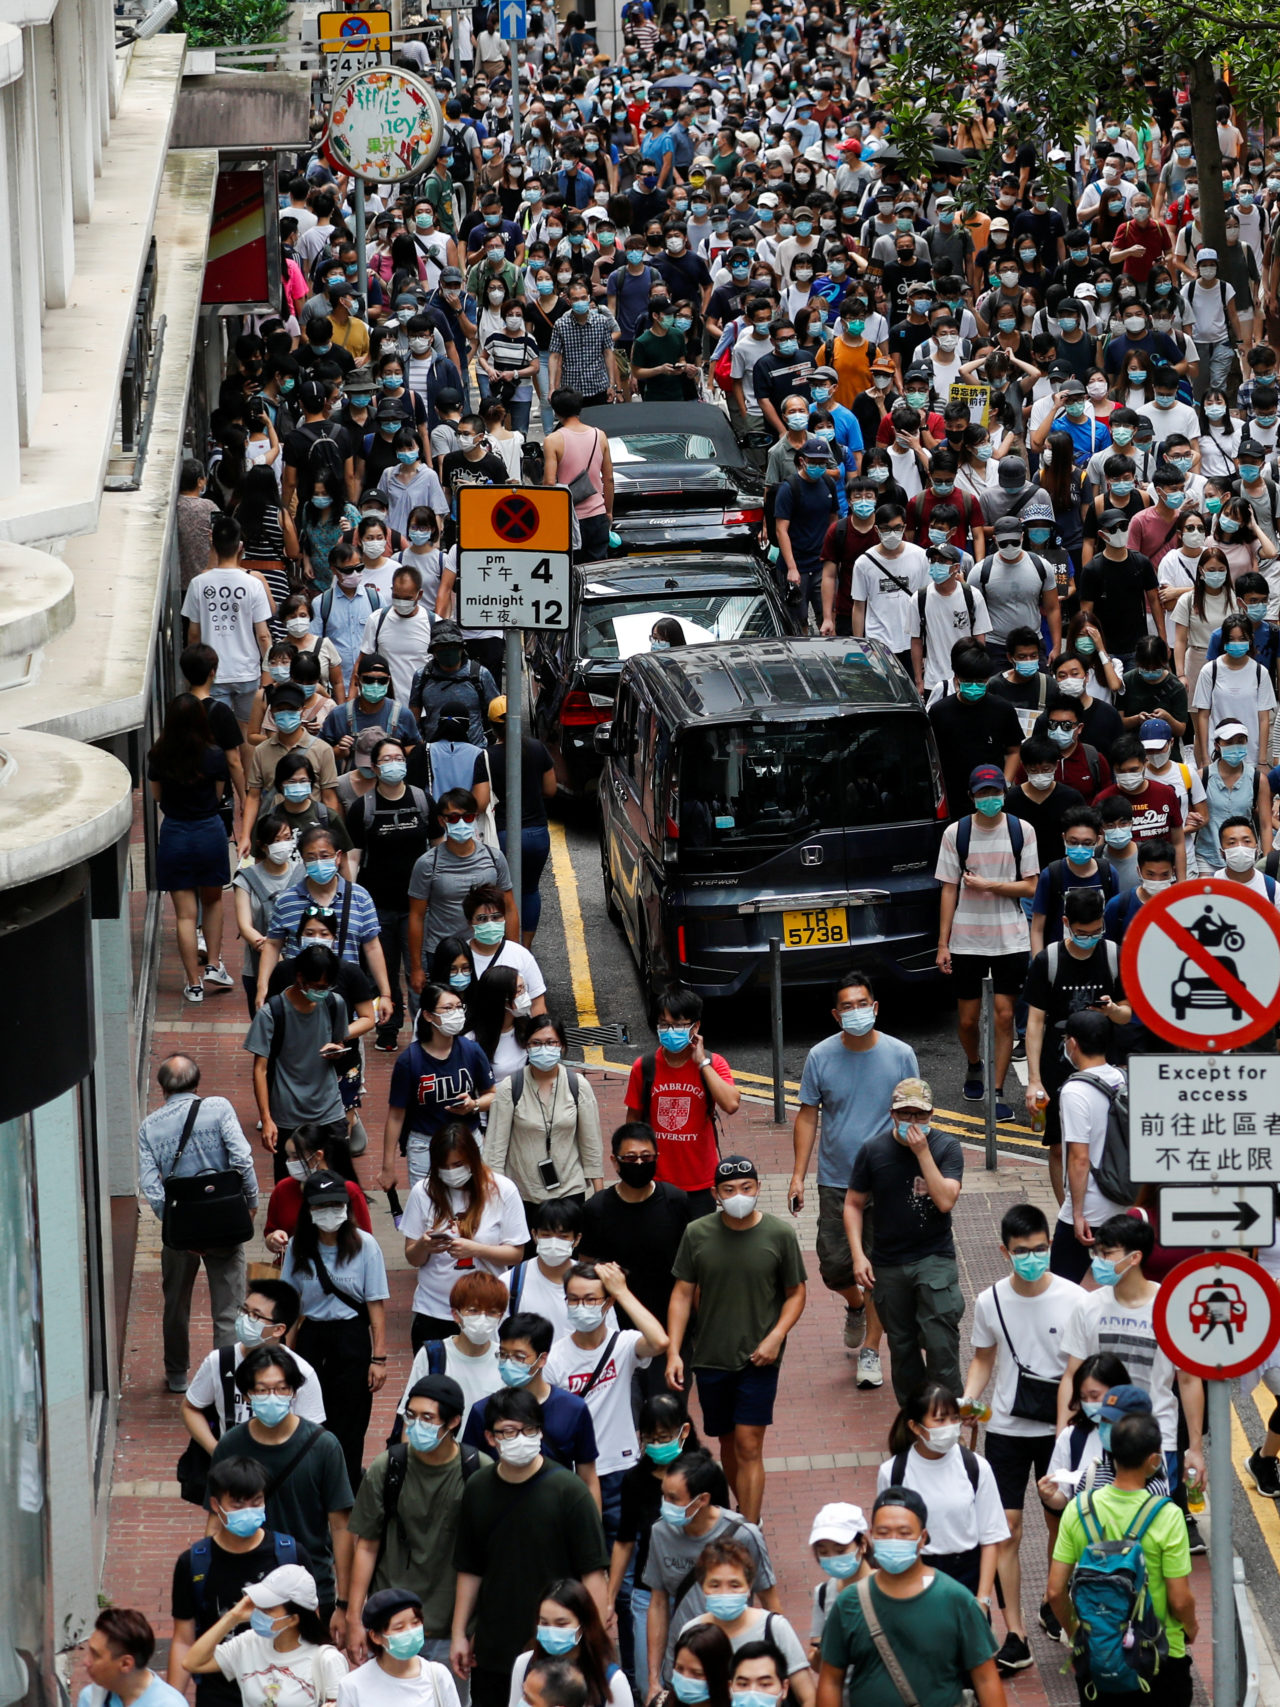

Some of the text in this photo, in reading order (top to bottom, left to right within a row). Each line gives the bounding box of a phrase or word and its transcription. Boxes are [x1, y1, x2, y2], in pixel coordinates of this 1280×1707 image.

[330, 59, 353, 72] 24
[380, 117, 416, 138] ney
[367, 137, 397, 154] 果汁
[478, 566, 513, 581] 下午
[487, 555, 553, 584] pm 4
[466, 594, 563, 625] midnight 12
[480, 610, 511, 624] 午夜
[801, 911, 829, 929] TR
[788, 926, 845, 946] 5738
[1158, 1064, 1268, 1082] Except for
[418, 1068, 474, 1105] FILA
[651, 1082, 705, 1099] AMBRIDGE
[1178, 1089, 1249, 1102] access
[1156, 1147, 1271, 1172] 不在此限
[1100, 1315, 1153, 1330] ADIDA
